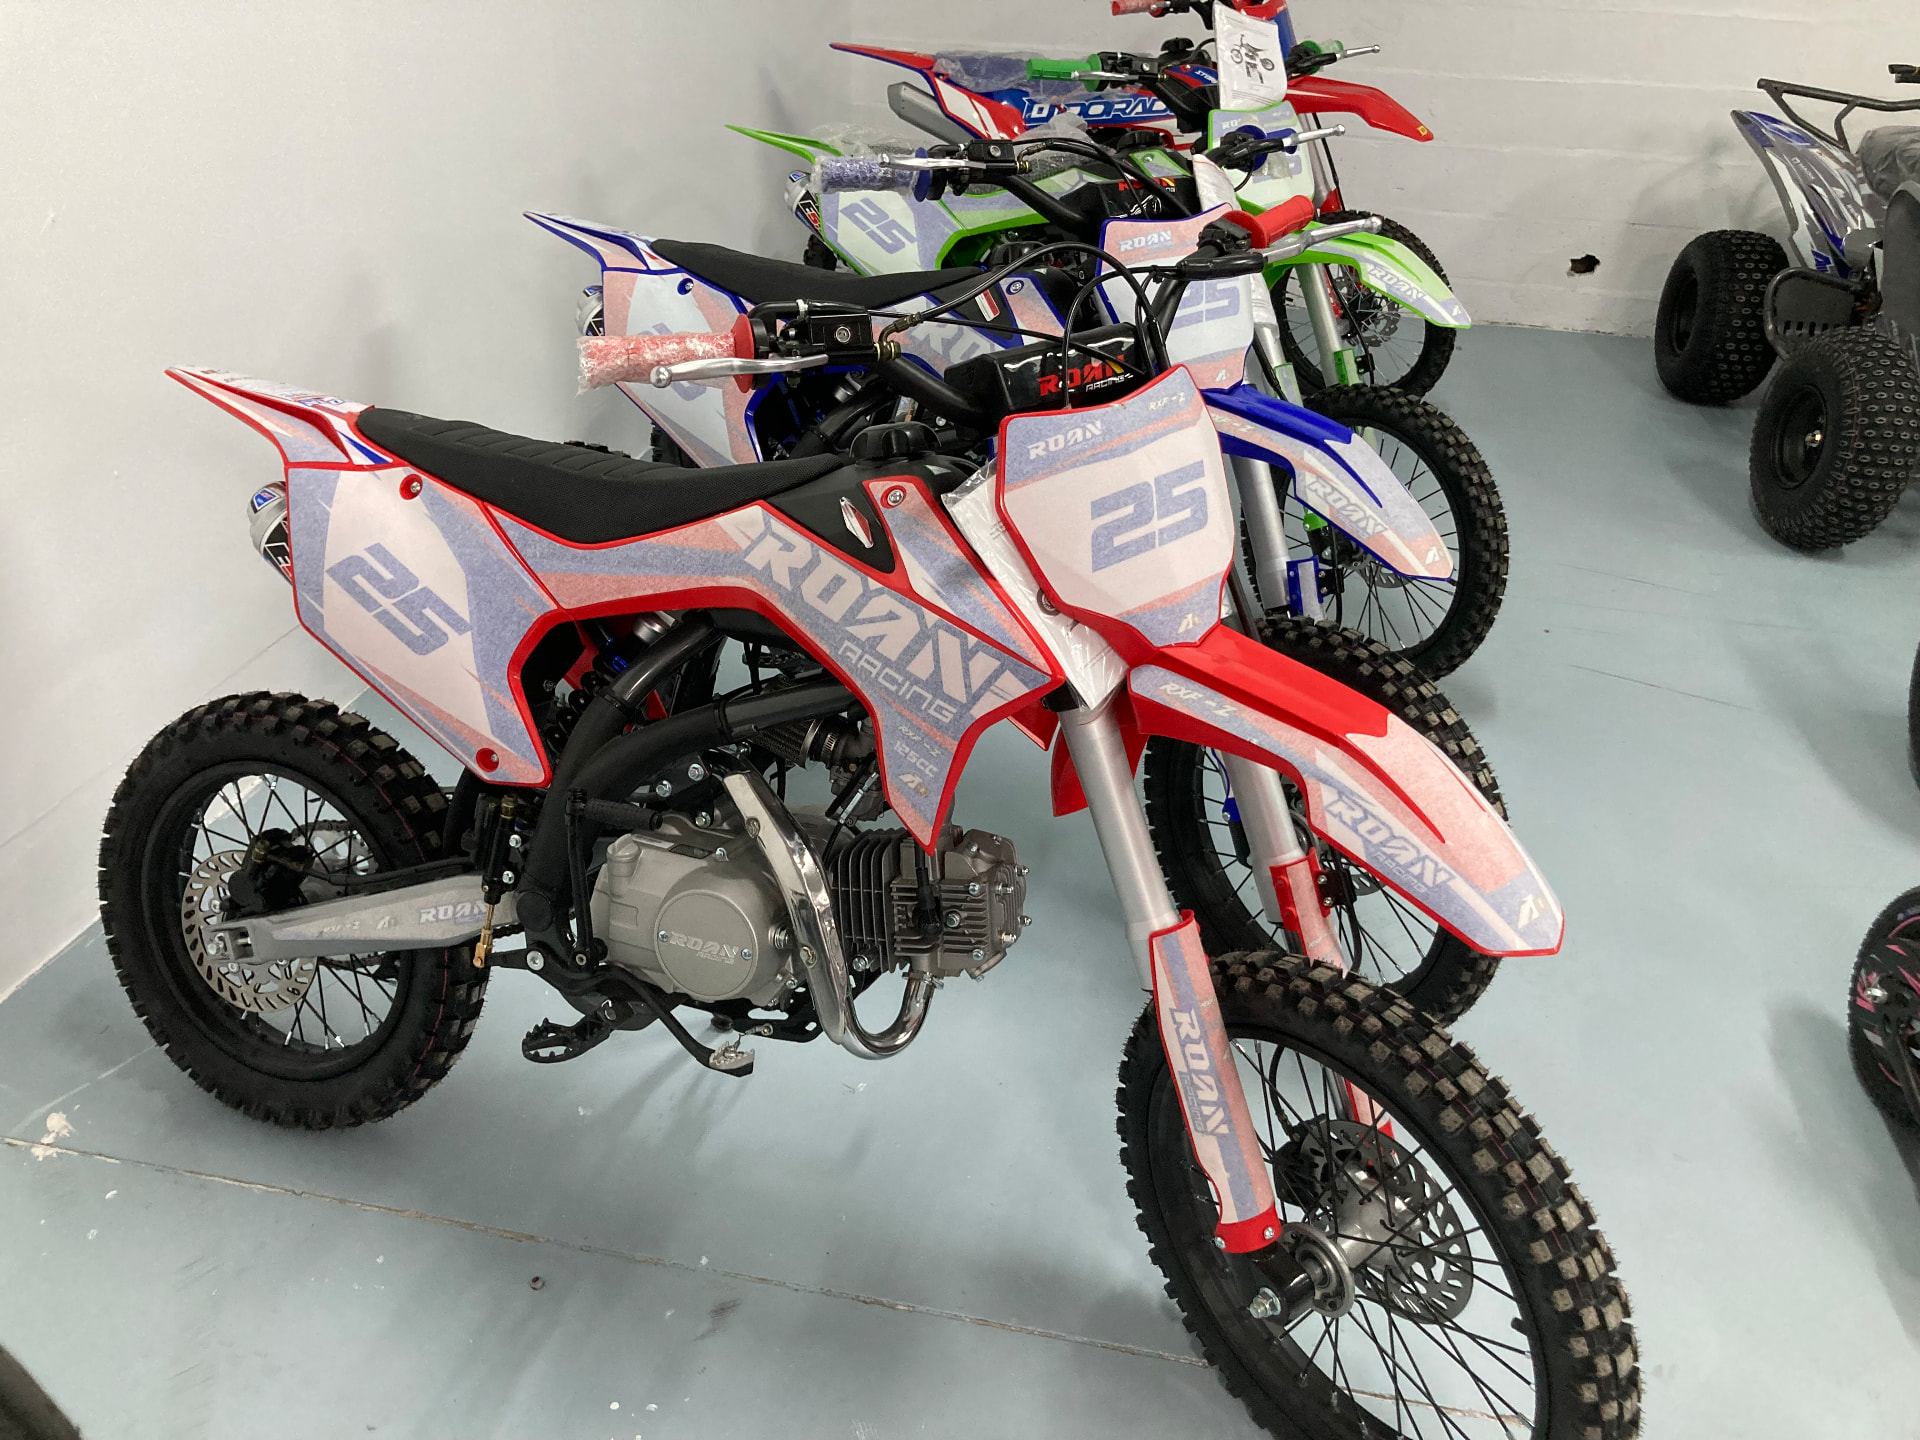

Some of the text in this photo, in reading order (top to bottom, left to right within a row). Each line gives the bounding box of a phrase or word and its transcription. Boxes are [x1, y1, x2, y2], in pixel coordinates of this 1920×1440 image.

[839, 197, 917, 255] 25
[1118, 229, 1172, 252] ROAN
[1367, 268, 1425, 300] ROAN
[1026, 420, 1104, 460] ROAN
[1090, 459, 1209, 574] 25
[1306, 477, 1389, 537] ROAN
[325, 541, 472, 656] 25
[745, 517, 1001, 704] ROAN
[838, 639, 958, 725] RACING
[894, 740, 940, 778] 125CC
[1326, 797, 1456, 886] ROAN
[669, 931, 740, 960] ROAN
[1170, 1007, 1230, 1136] ROAN
